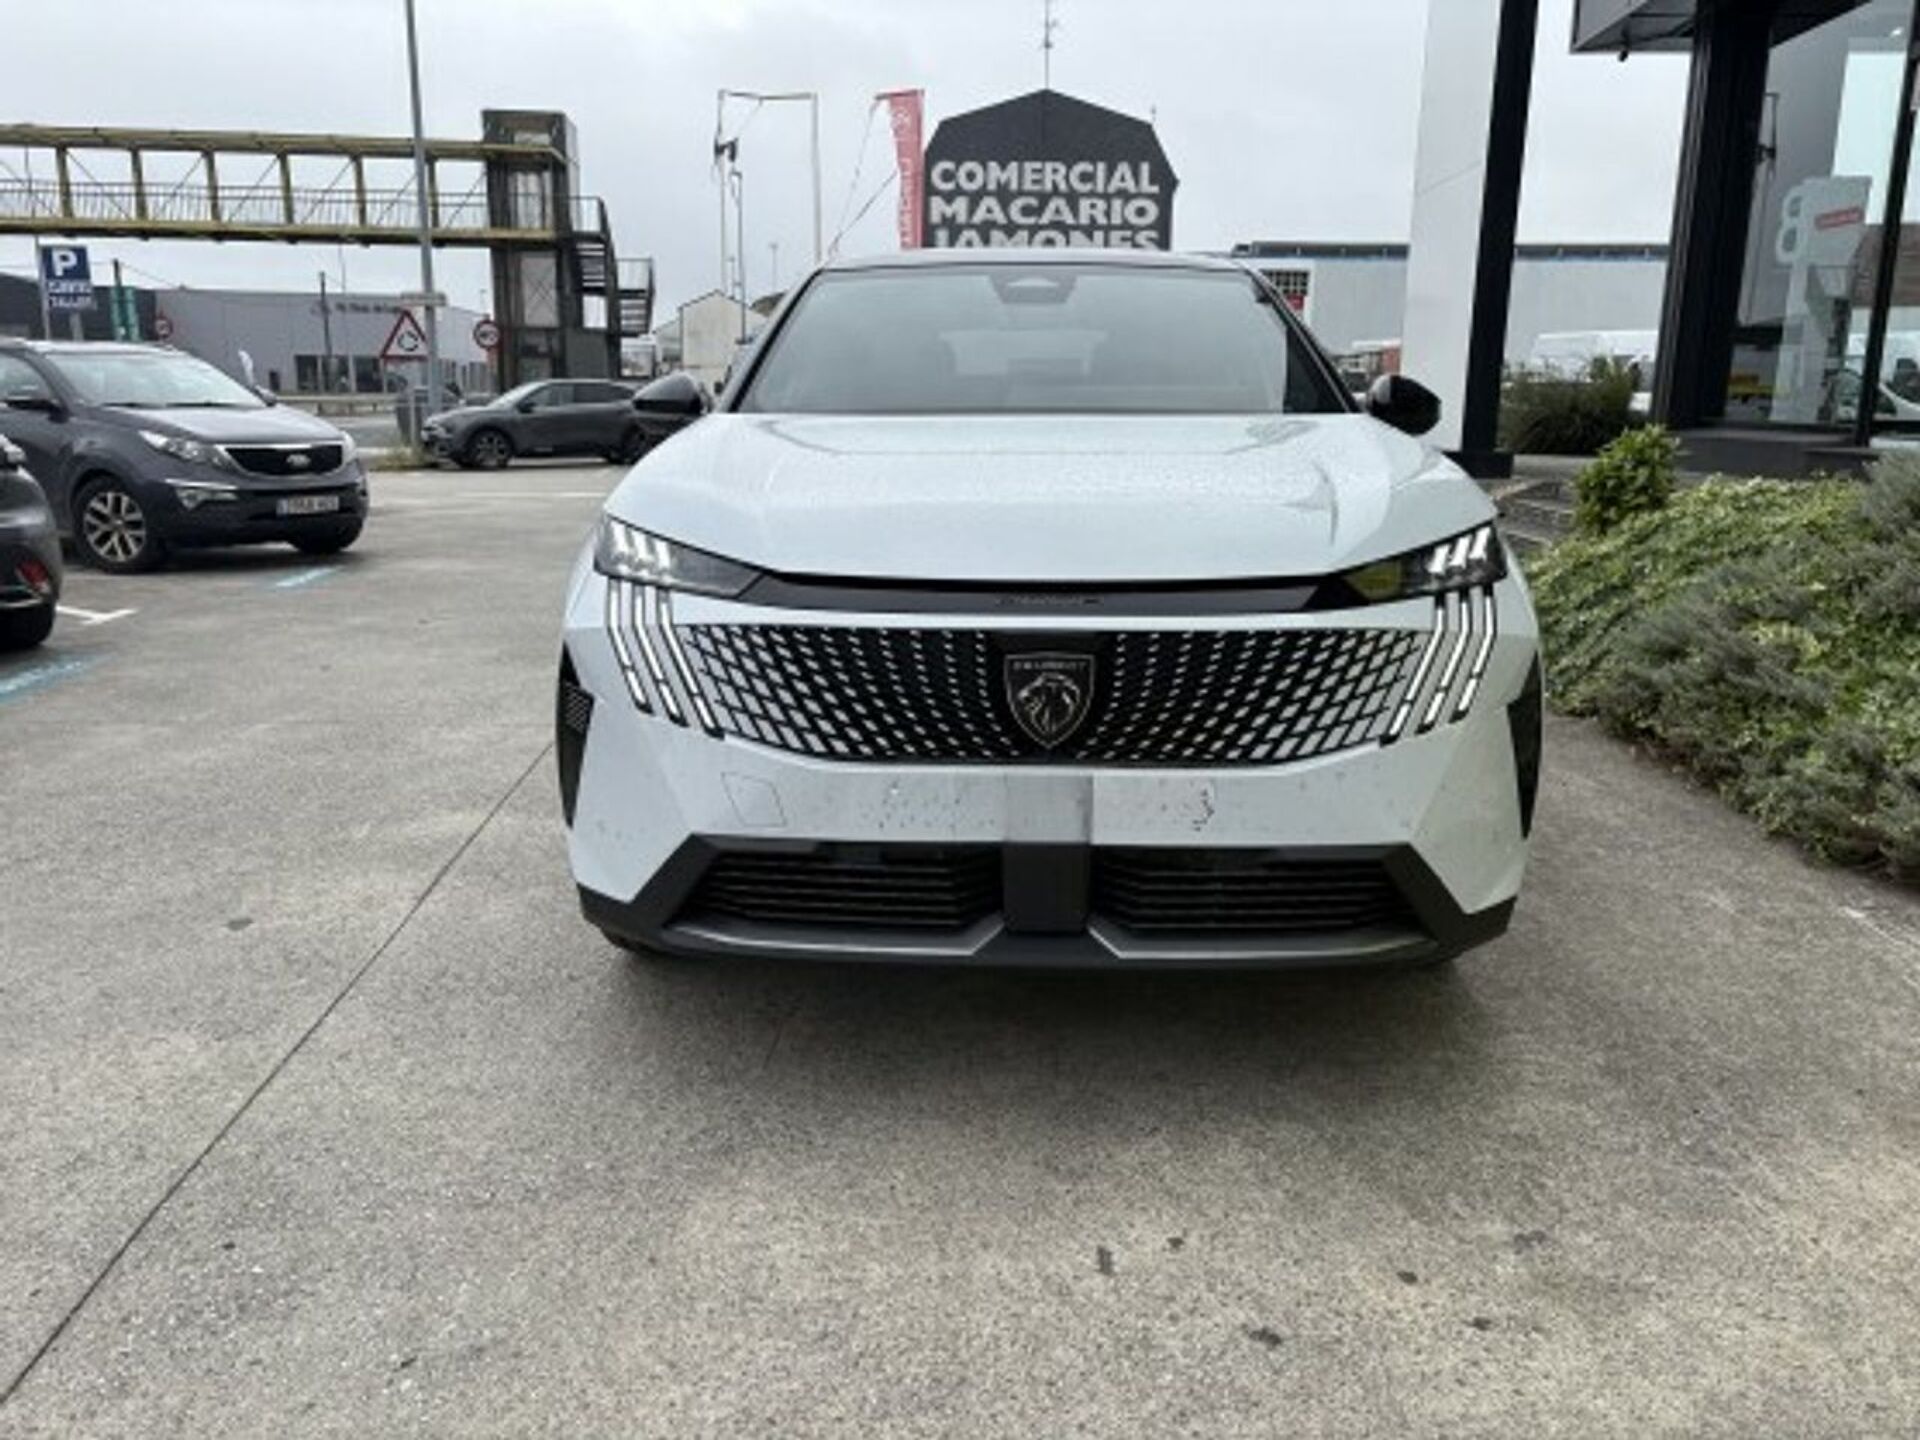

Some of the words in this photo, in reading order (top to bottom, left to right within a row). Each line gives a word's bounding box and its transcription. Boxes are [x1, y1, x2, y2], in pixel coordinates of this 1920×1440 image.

[930, 160, 1160, 194] COMERCIAL
[929, 195, 1159, 226] MACARIO
[52, 249, 77, 276] P
